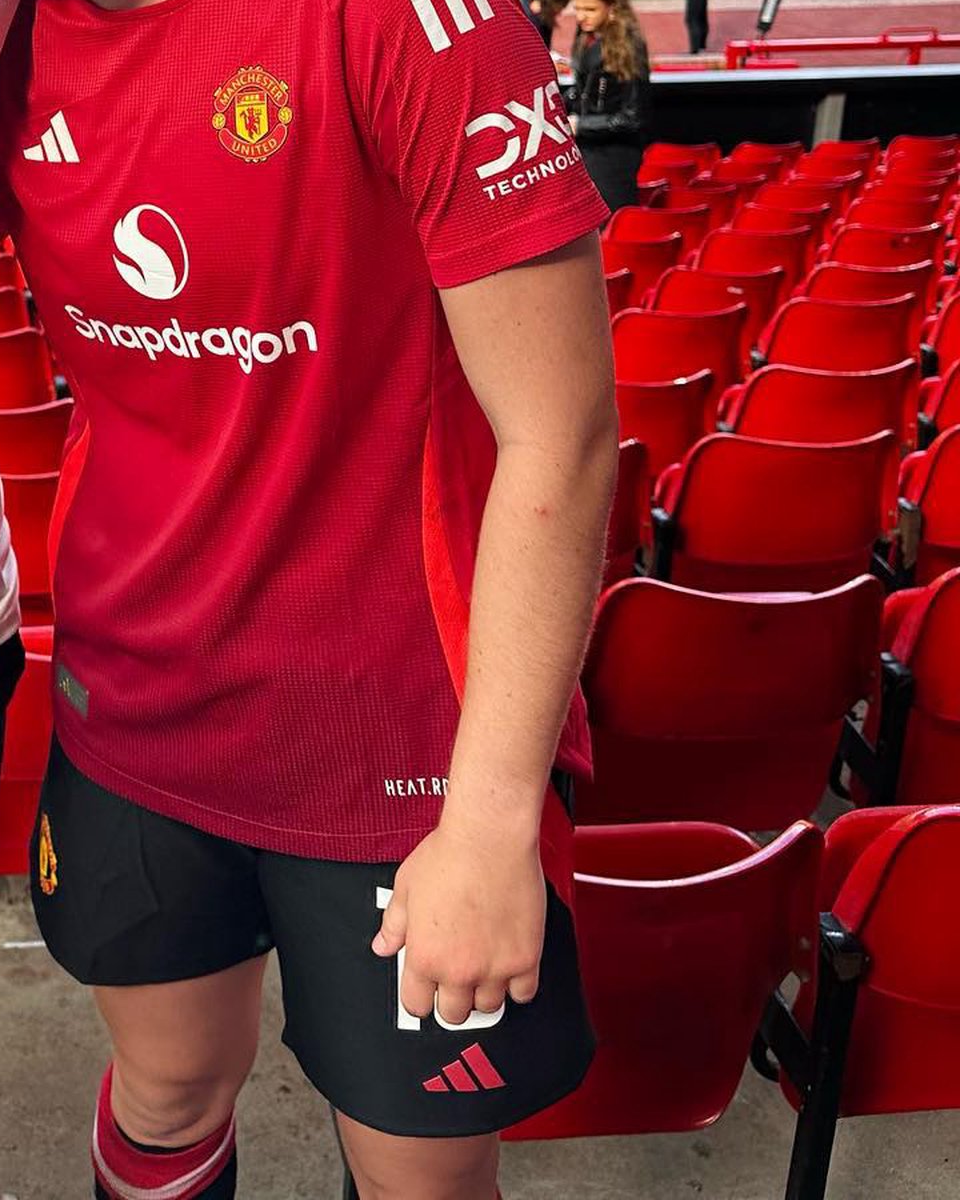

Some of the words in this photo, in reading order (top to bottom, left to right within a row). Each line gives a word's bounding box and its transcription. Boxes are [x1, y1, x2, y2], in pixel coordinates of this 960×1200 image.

[218, 72, 283, 106] MANCHESTER
[231, 138, 278, 157] UNITED
[64, 304, 318, 375] Snapdragon
